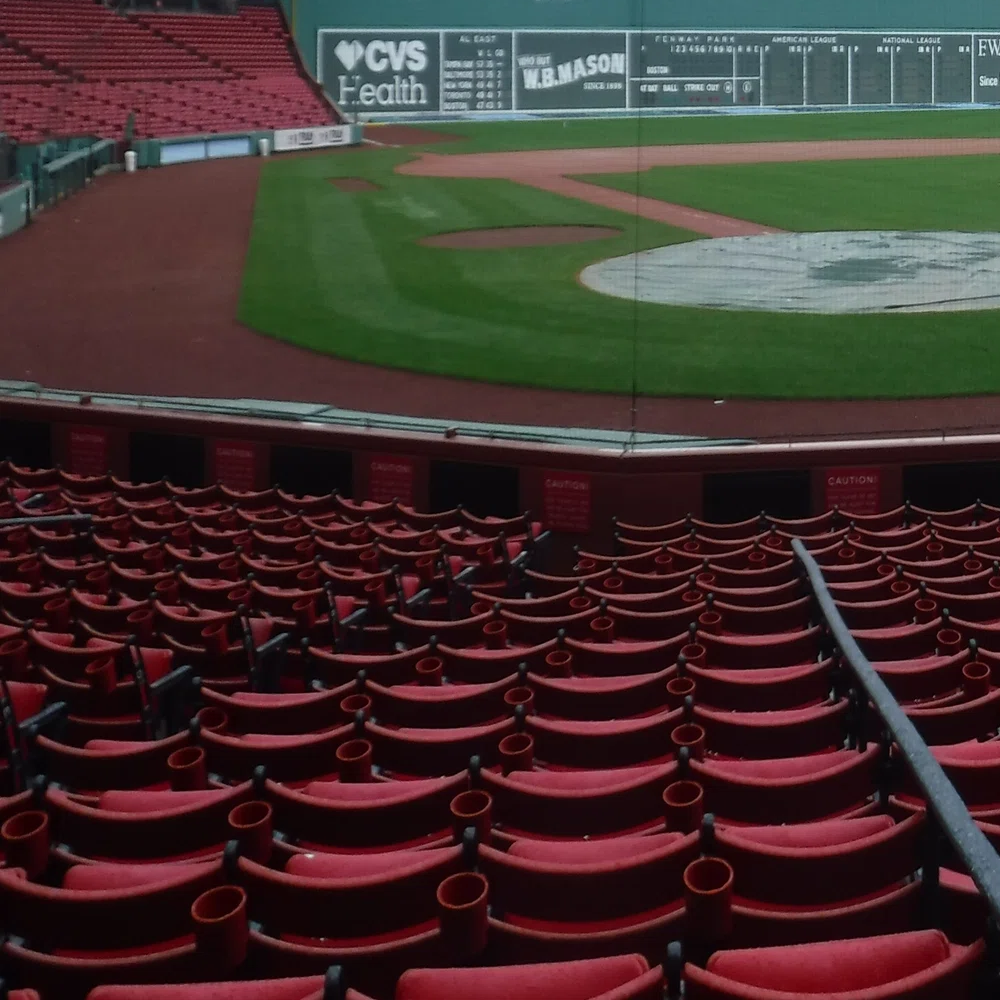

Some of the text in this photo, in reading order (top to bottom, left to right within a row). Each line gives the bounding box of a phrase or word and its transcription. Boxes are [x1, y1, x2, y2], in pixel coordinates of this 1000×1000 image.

[365, 39, 428, 72] CVS
[337, 75, 428, 105] Health
[979, 76, 998, 86] Since
